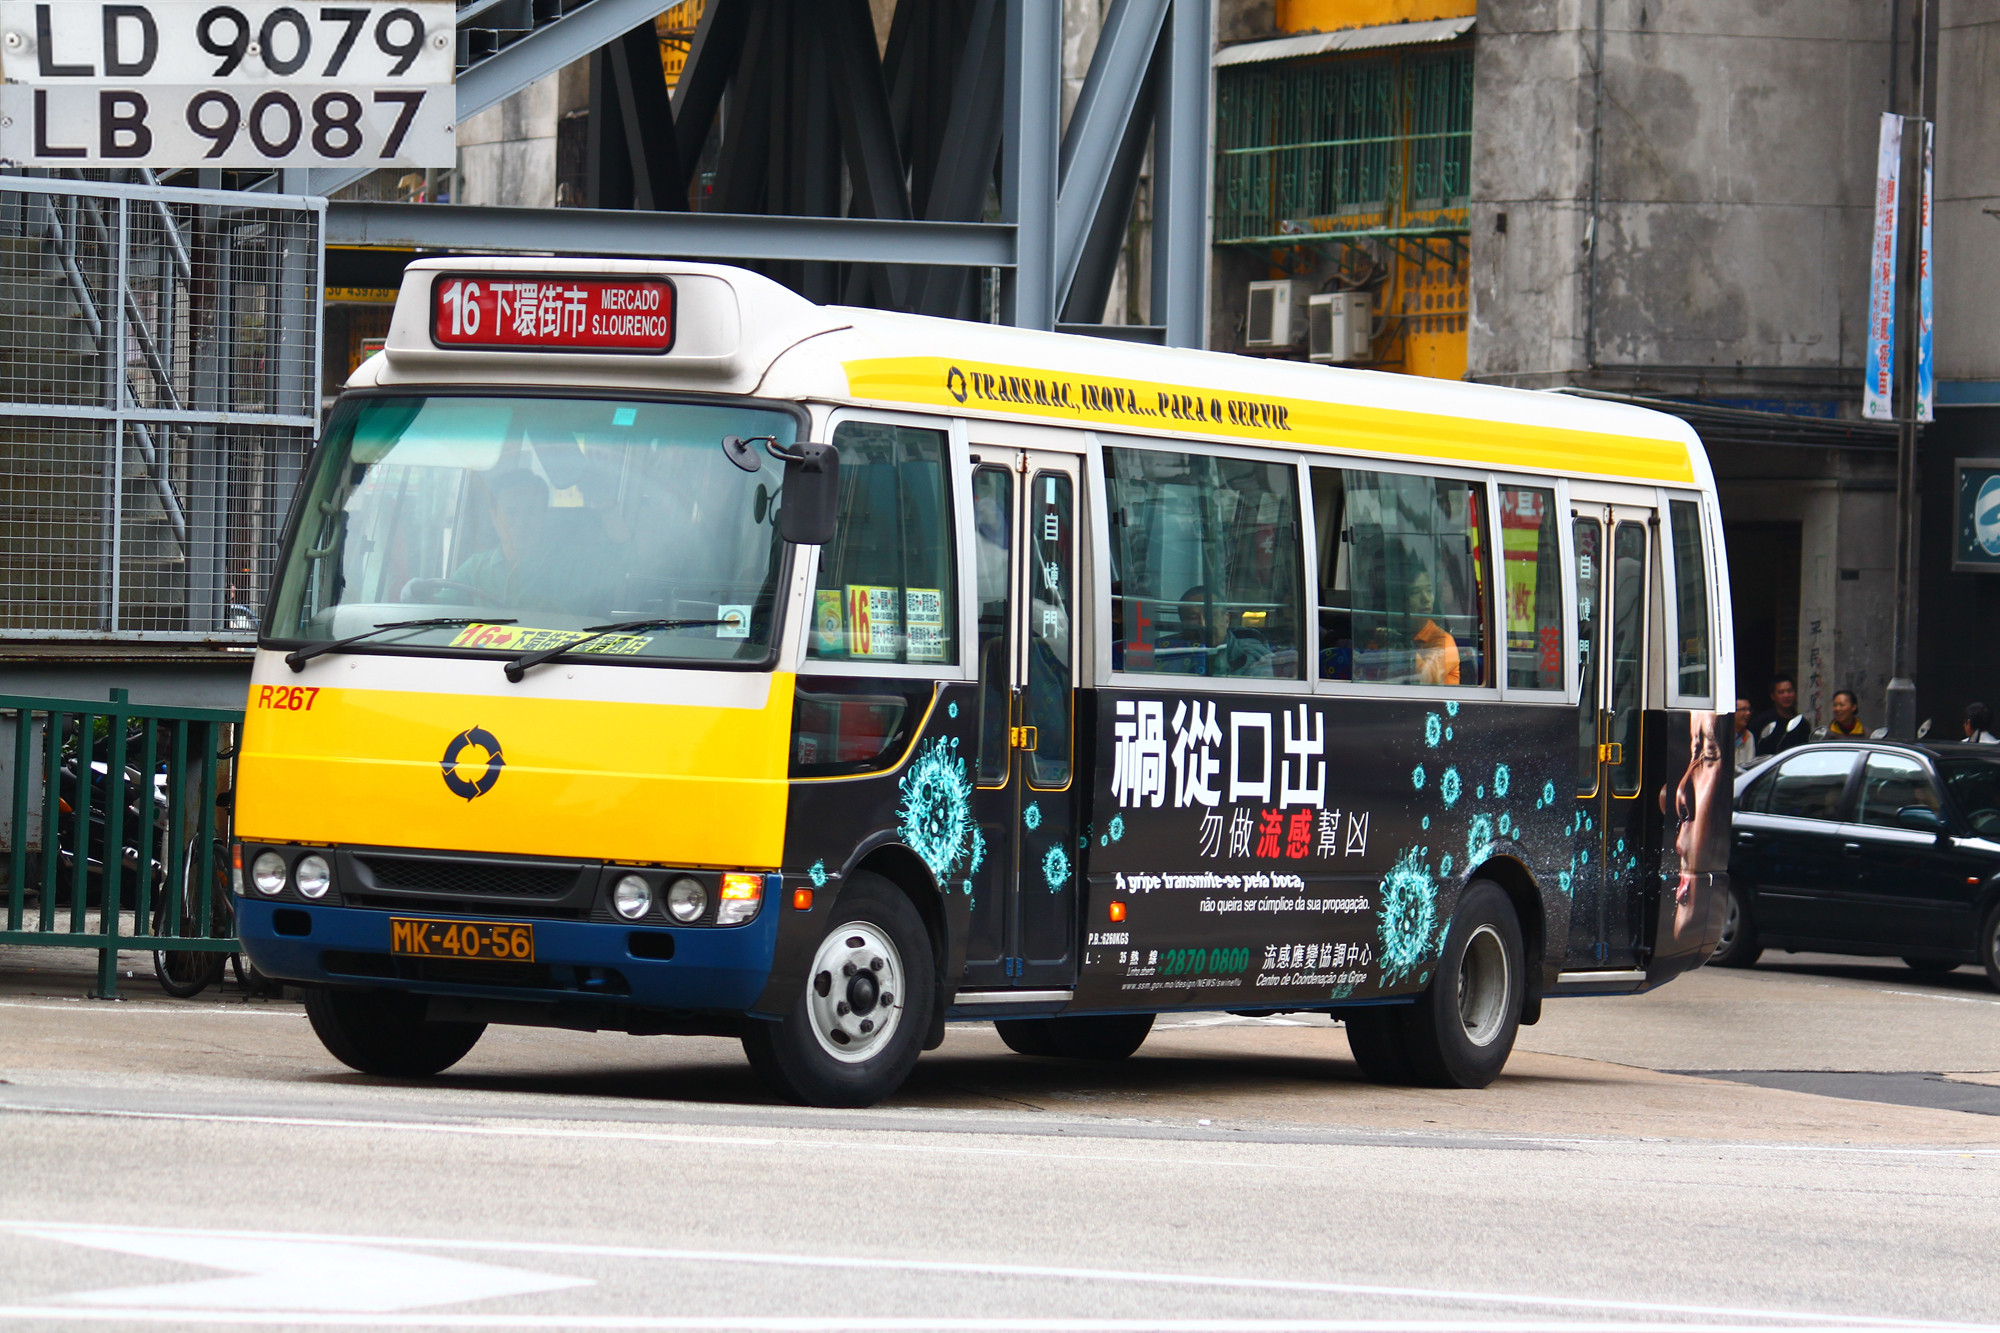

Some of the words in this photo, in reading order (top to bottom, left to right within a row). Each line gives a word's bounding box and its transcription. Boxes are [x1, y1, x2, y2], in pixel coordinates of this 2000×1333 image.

[443, 282, 481, 335] 16
[489, 283, 588, 337] 下環街市
[601, 289, 659, 310] MERCADO
[592, 314, 667, 336] S.LOURENCO
[1158, 392, 1208, 422] PARA
[1210, 398, 1222, 424] O
[1228, 400, 1292, 431] SERVIR
[850, 589, 870, 654] 16
[460, 626, 502, 647] 16
[1539, 625, 1560, 673] 落
[258, 685, 320, 711] R267
[1111, 700, 1326, 809] 禍從口出
[1199, 806, 1369, 859] 勿做流感幫凶
[1115, 872, 1126, 890] A
[1127, 871, 1161, 894] gripe
[1162, 871, 1241, 889] transmite-se
[1244, 871, 1270, 892] pela
[1271, 871, 1305, 892] boca,
[1200, 897, 1215, 911] não
[1217, 896, 1242, 914] queira
[1244, 899, 1256, 911] ser
[1258, 896, 1293, 914] cúmplice
[1295, 896, 1306, 911] da
[1307, 899, 1321, 910] sua
[1322, 895, 1370, 913] propagação.
[393, 921, 531, 958] MK-40-56
[1119, 951, 1127, 964] 35
[1209, 947, 1250, 974] 0800
[1262, 943, 1372, 969] 流感應變協調中心
[1256, 974, 1280, 986] Centro
[1280, 973, 1290, 985] de
[1291, 972, 1336, 987] Coordenação
[1337, 972, 1347, 984] da
[1348, 970, 1368, 986] Gripe
